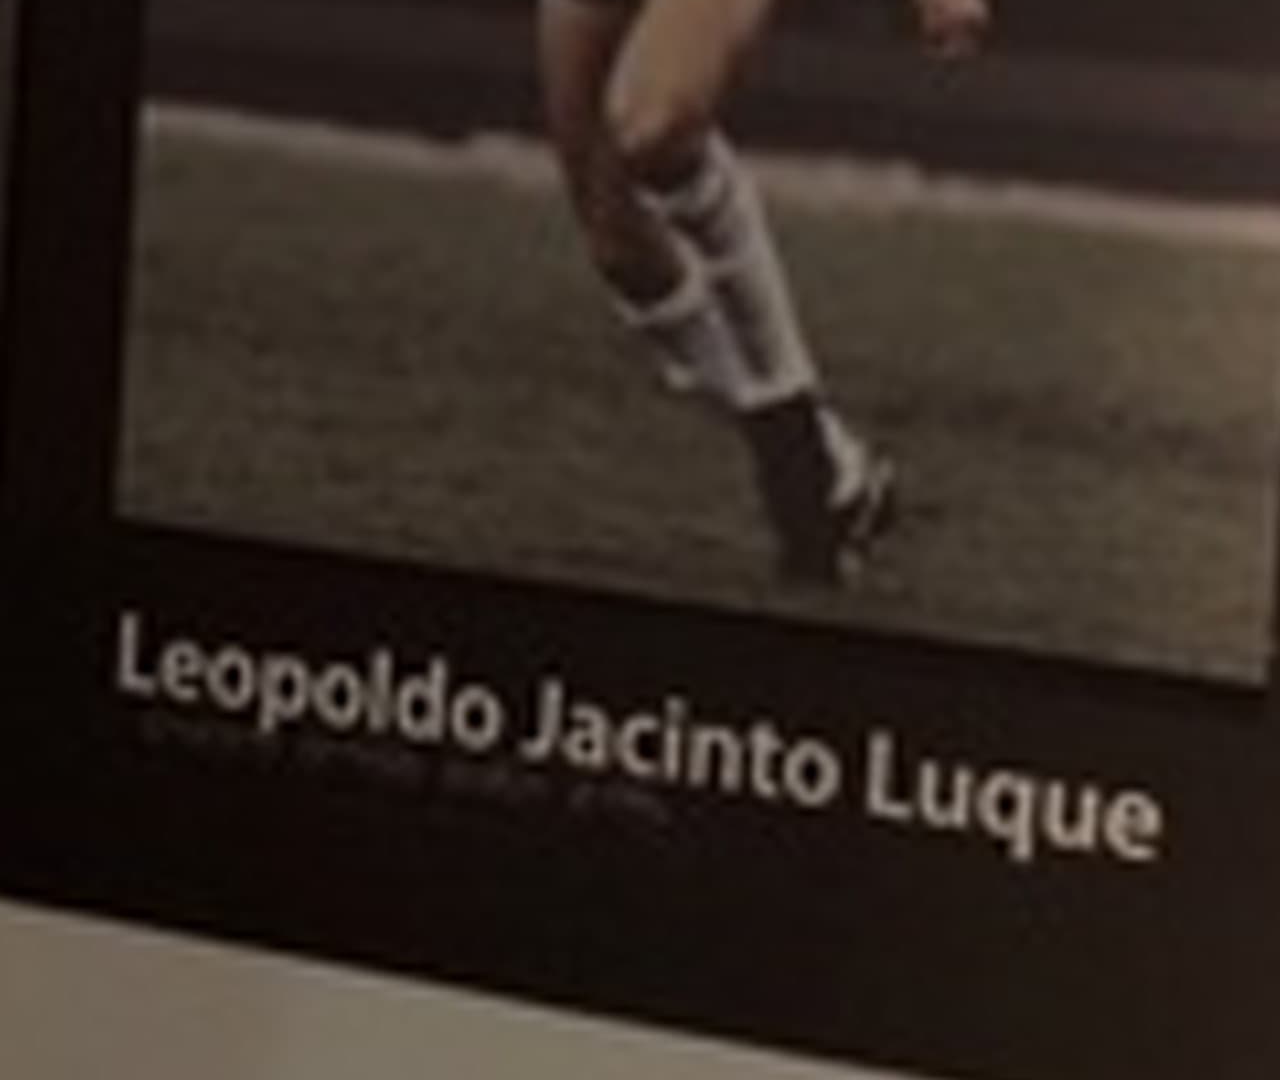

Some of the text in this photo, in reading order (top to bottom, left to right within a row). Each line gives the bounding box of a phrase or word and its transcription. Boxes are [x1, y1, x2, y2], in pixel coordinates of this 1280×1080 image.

[118, 614, 503, 750] Leopoldo
[520, 679, 841, 806] Jacinto
[866, 732, 1164, 863] Luque
